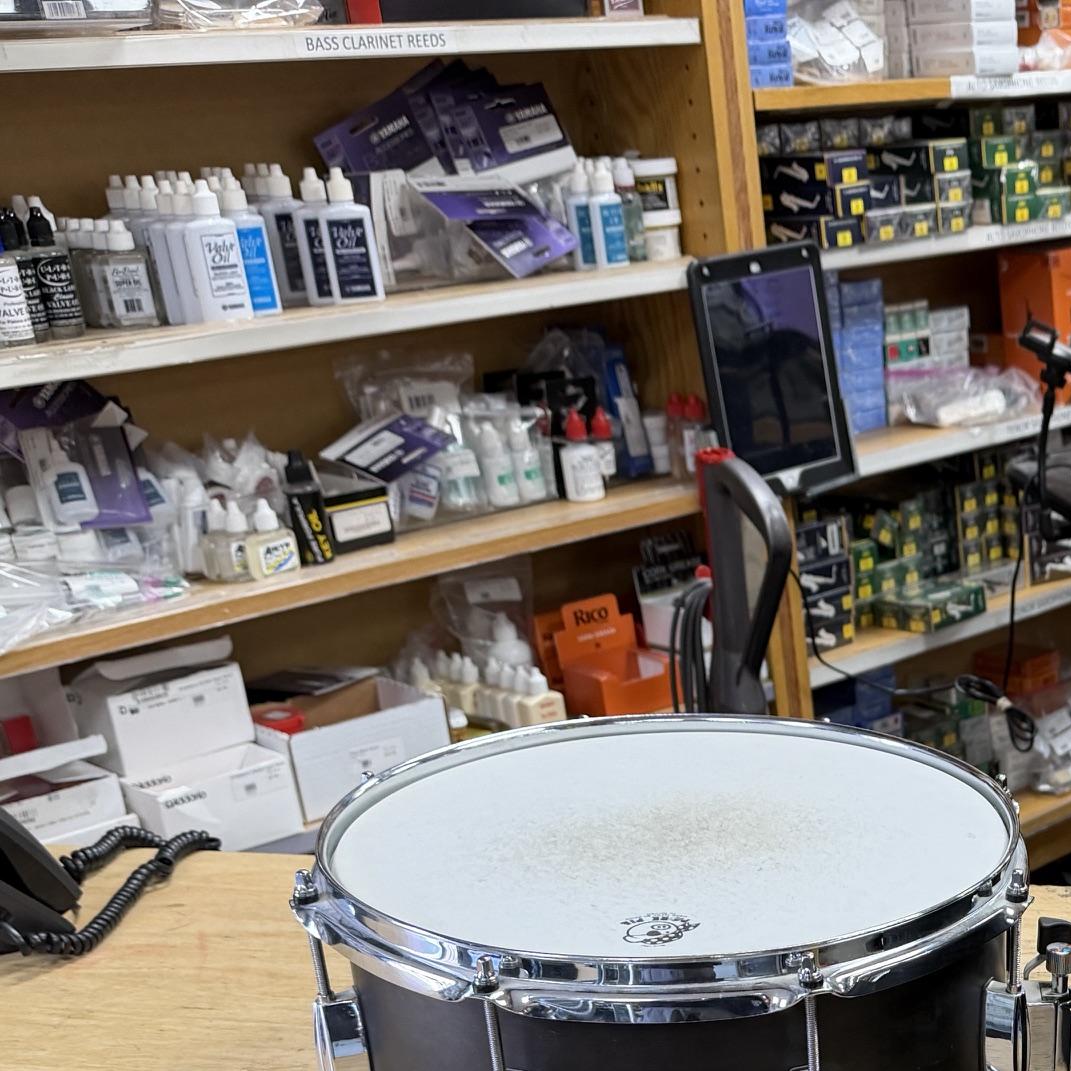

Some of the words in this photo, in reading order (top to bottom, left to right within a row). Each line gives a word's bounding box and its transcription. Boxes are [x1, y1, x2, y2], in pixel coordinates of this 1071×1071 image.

[305, 36, 339, 51] BASS
[342, 34, 403, 50] CLARINET
[407, 33, 446, 48] REEDS
[515, 102, 547, 121] YAMAHA
[379, 115, 410, 138] YAMAHA
[336, 235, 357, 249] Oil
[211, 251, 231, 265] Oil
[573, 607, 609, 626] RICO
